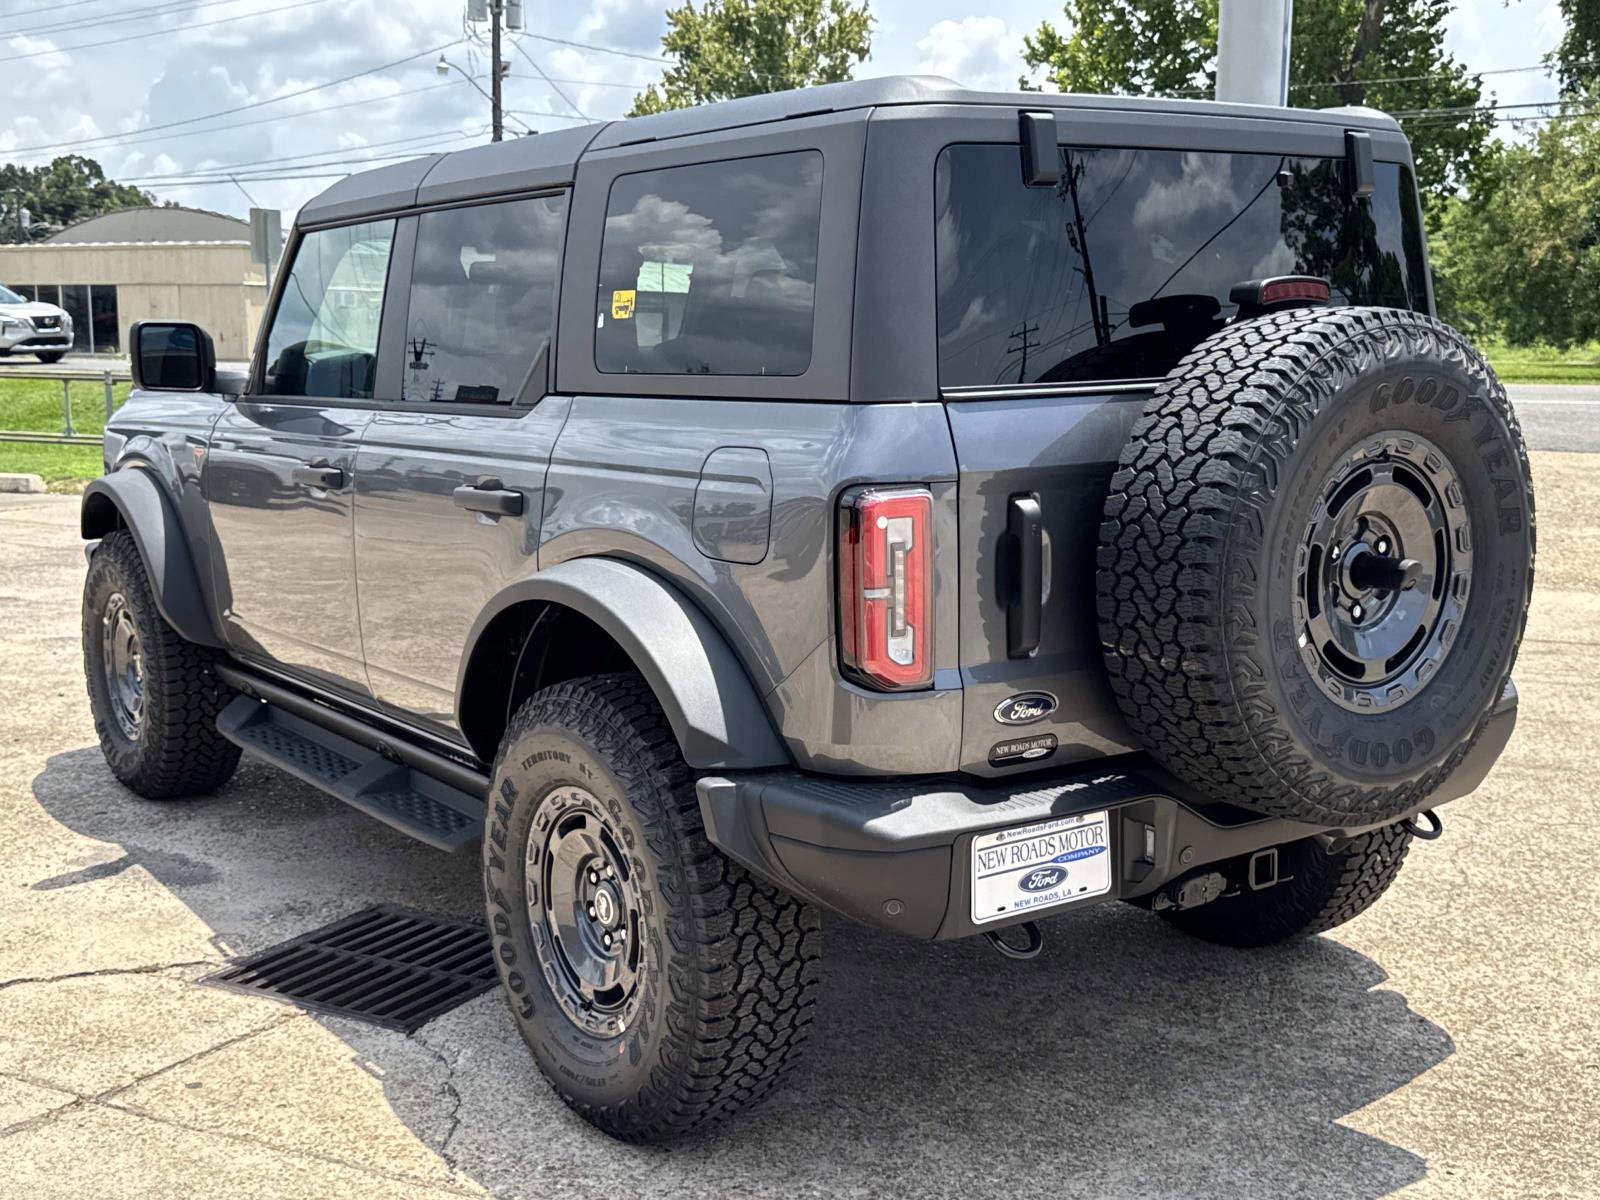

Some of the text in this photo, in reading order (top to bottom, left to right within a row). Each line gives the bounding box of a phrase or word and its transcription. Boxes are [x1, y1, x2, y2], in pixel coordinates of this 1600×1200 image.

[1369, 376, 1522, 536] GOODYEAR
[1273, 617, 1436, 769] GOODYEAR
[1010, 701, 1044, 720] Ford
[995, 738, 1052, 755] NEW ROADS MOTOR
[521, 750, 593, 780] TERRITORY RT
[1006, 817, 1075, 838] NewRoadsFord.com
[977, 825, 1104, 873] NEW ROADS MOTOR
[1057, 848, 1102, 863] COMPANY
[1028, 870, 1059, 889] Ford
[487, 777, 534, 1021] GOODYEAR
[1014, 889, 1072, 909] NEW ROADS, LA
